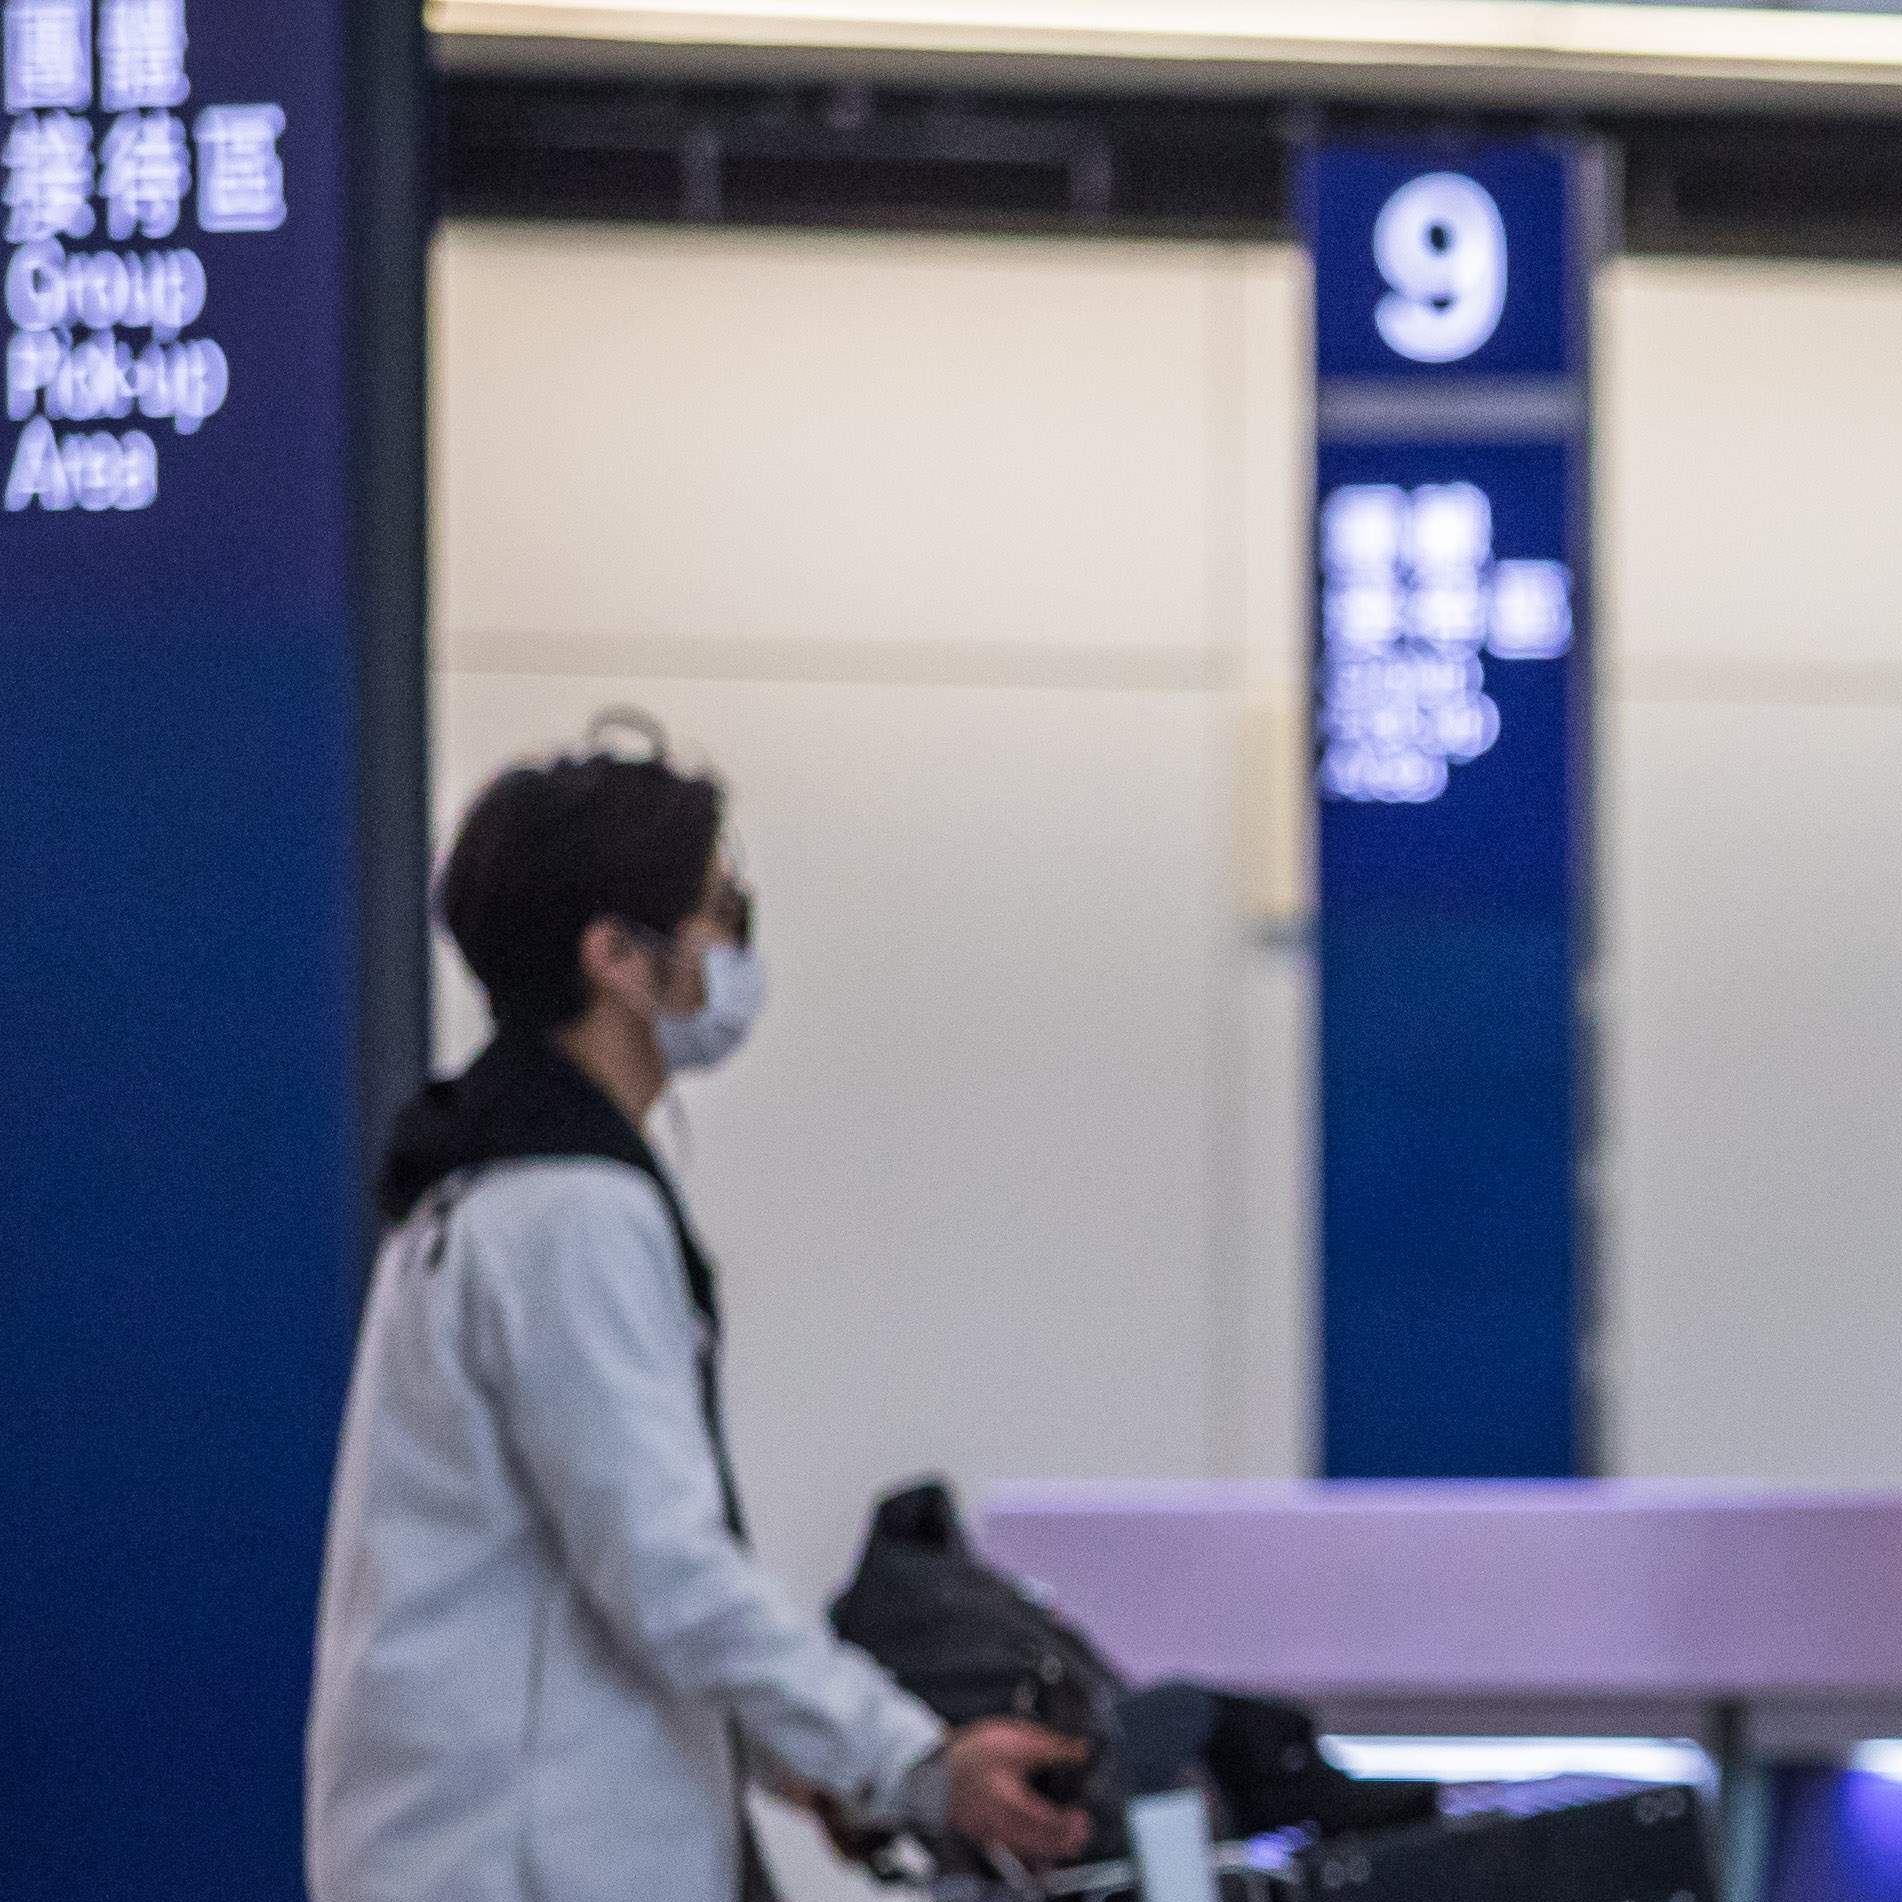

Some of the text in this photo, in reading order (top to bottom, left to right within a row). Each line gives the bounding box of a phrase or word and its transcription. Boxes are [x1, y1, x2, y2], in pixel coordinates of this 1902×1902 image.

[6, 237, 208, 341] Group
[1373, 172, 1507, 363] 9
[3, 415, 158, 511] Area
